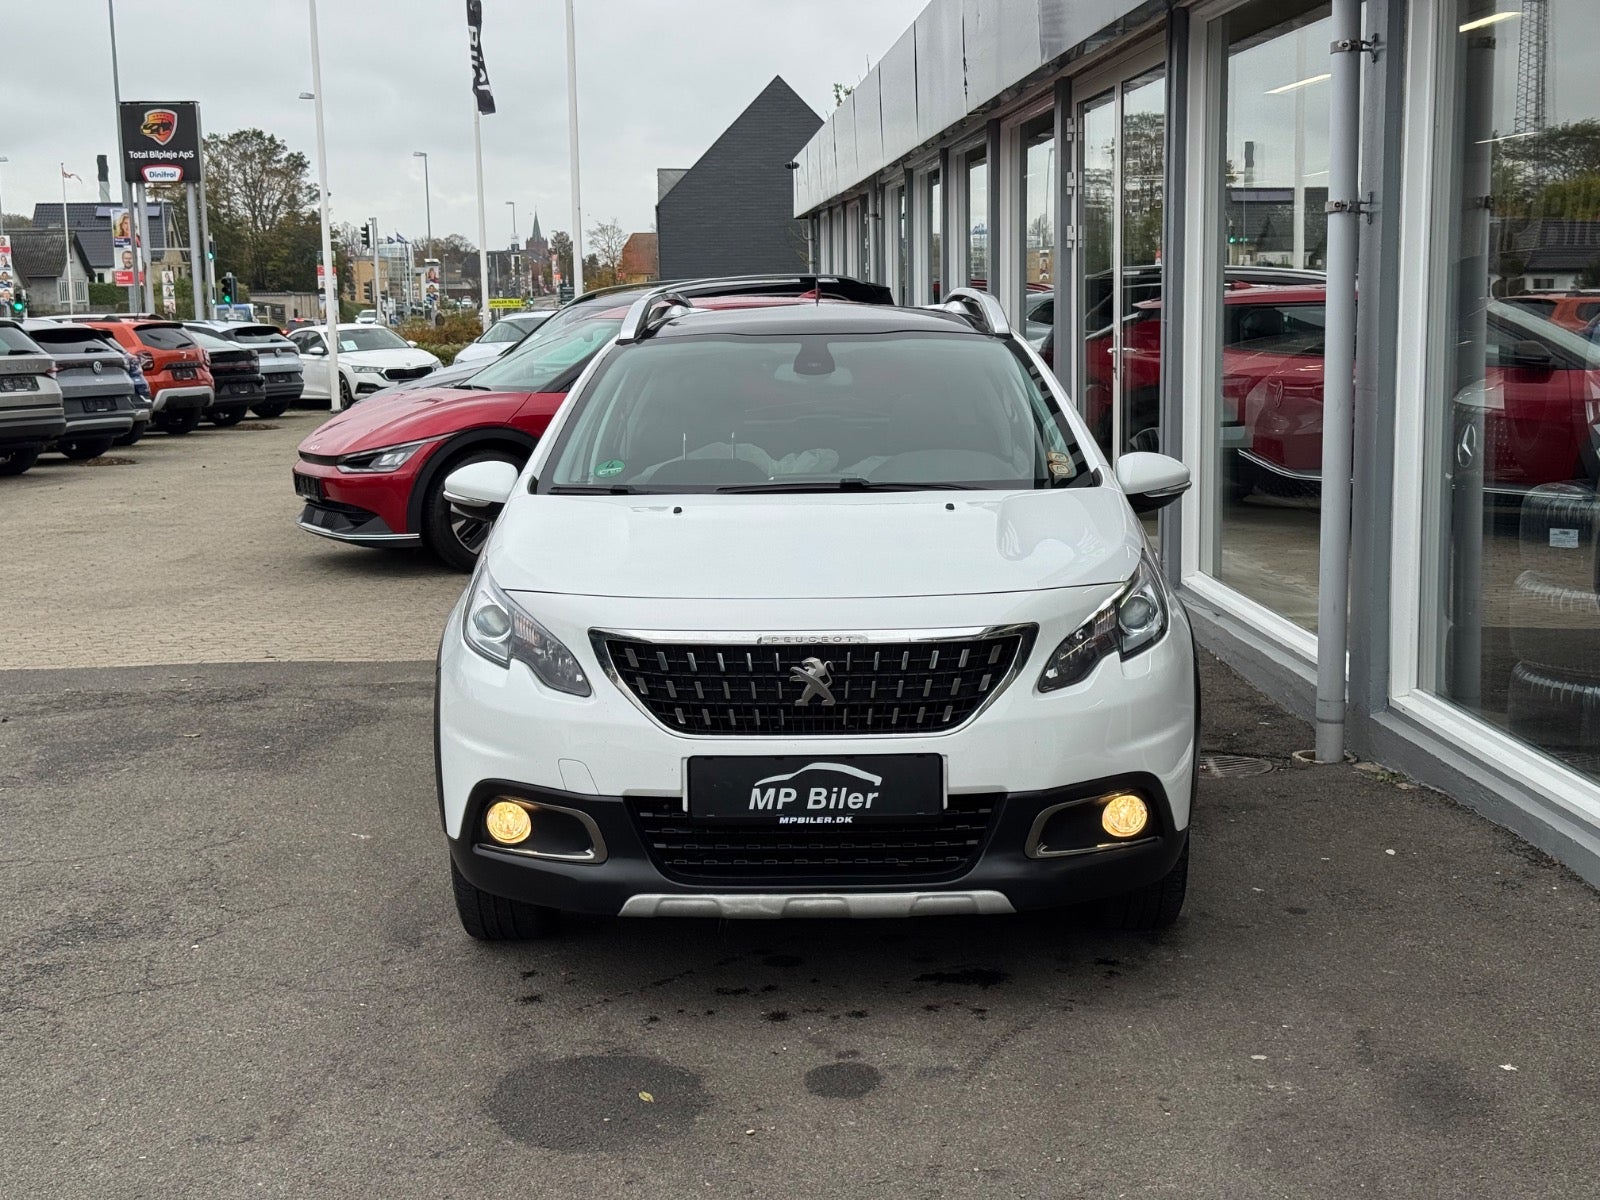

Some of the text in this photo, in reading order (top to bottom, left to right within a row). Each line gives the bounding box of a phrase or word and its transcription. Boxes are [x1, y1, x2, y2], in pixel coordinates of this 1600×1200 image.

[128, 151, 194, 160] Total Bilpleje ApS
[748, 787, 879, 810] MP Biler
[779, 816, 853, 824] MPBILER.DK
